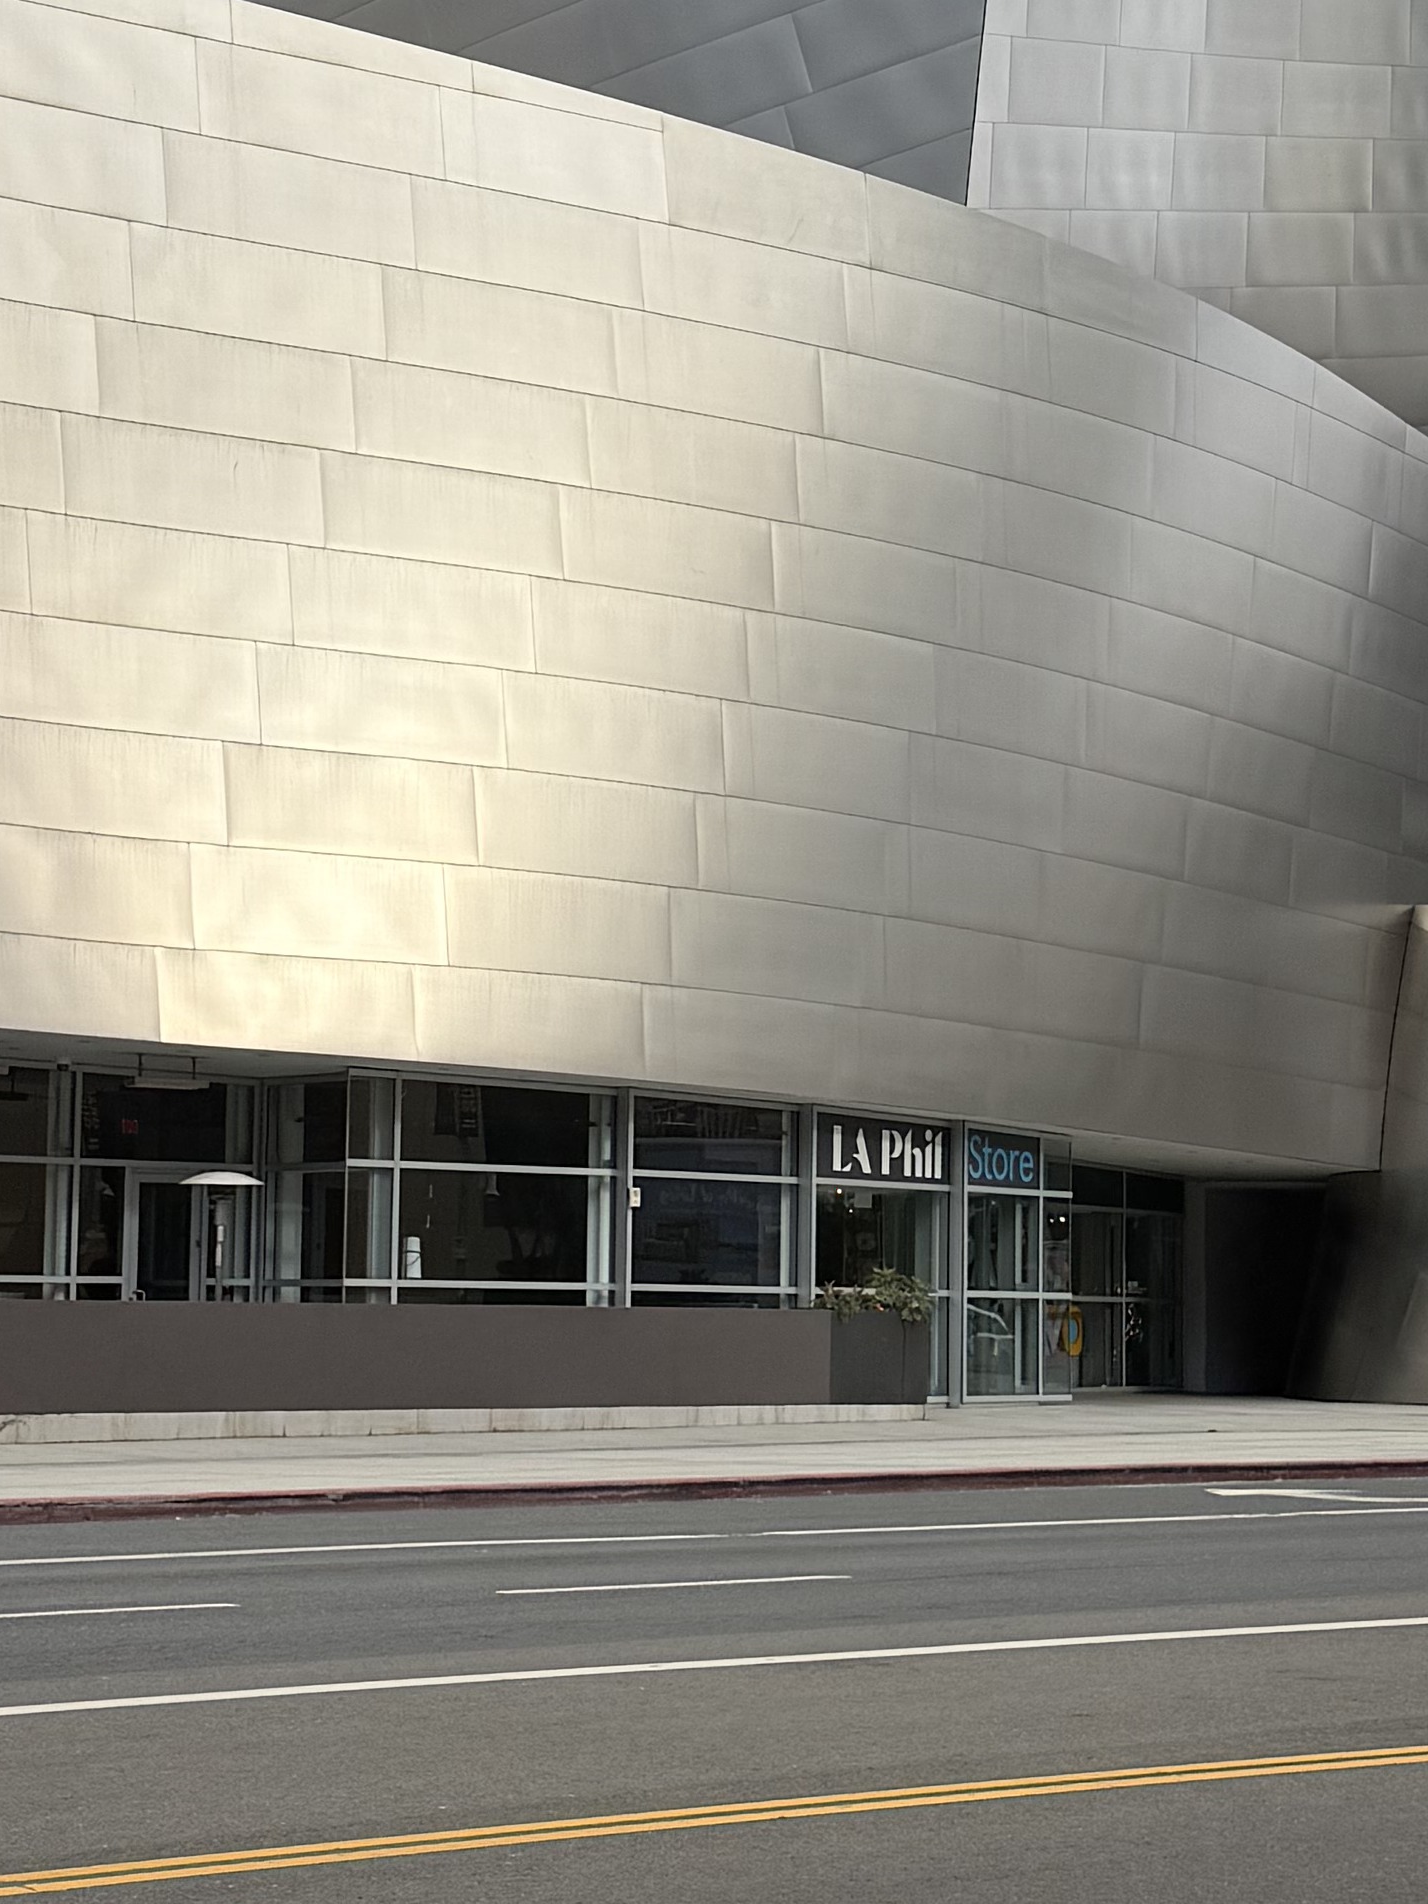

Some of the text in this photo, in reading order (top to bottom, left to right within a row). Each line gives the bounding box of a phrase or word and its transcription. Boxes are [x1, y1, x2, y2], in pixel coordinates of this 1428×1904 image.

[832, 1124, 1035, 1183] LA Phil Store
